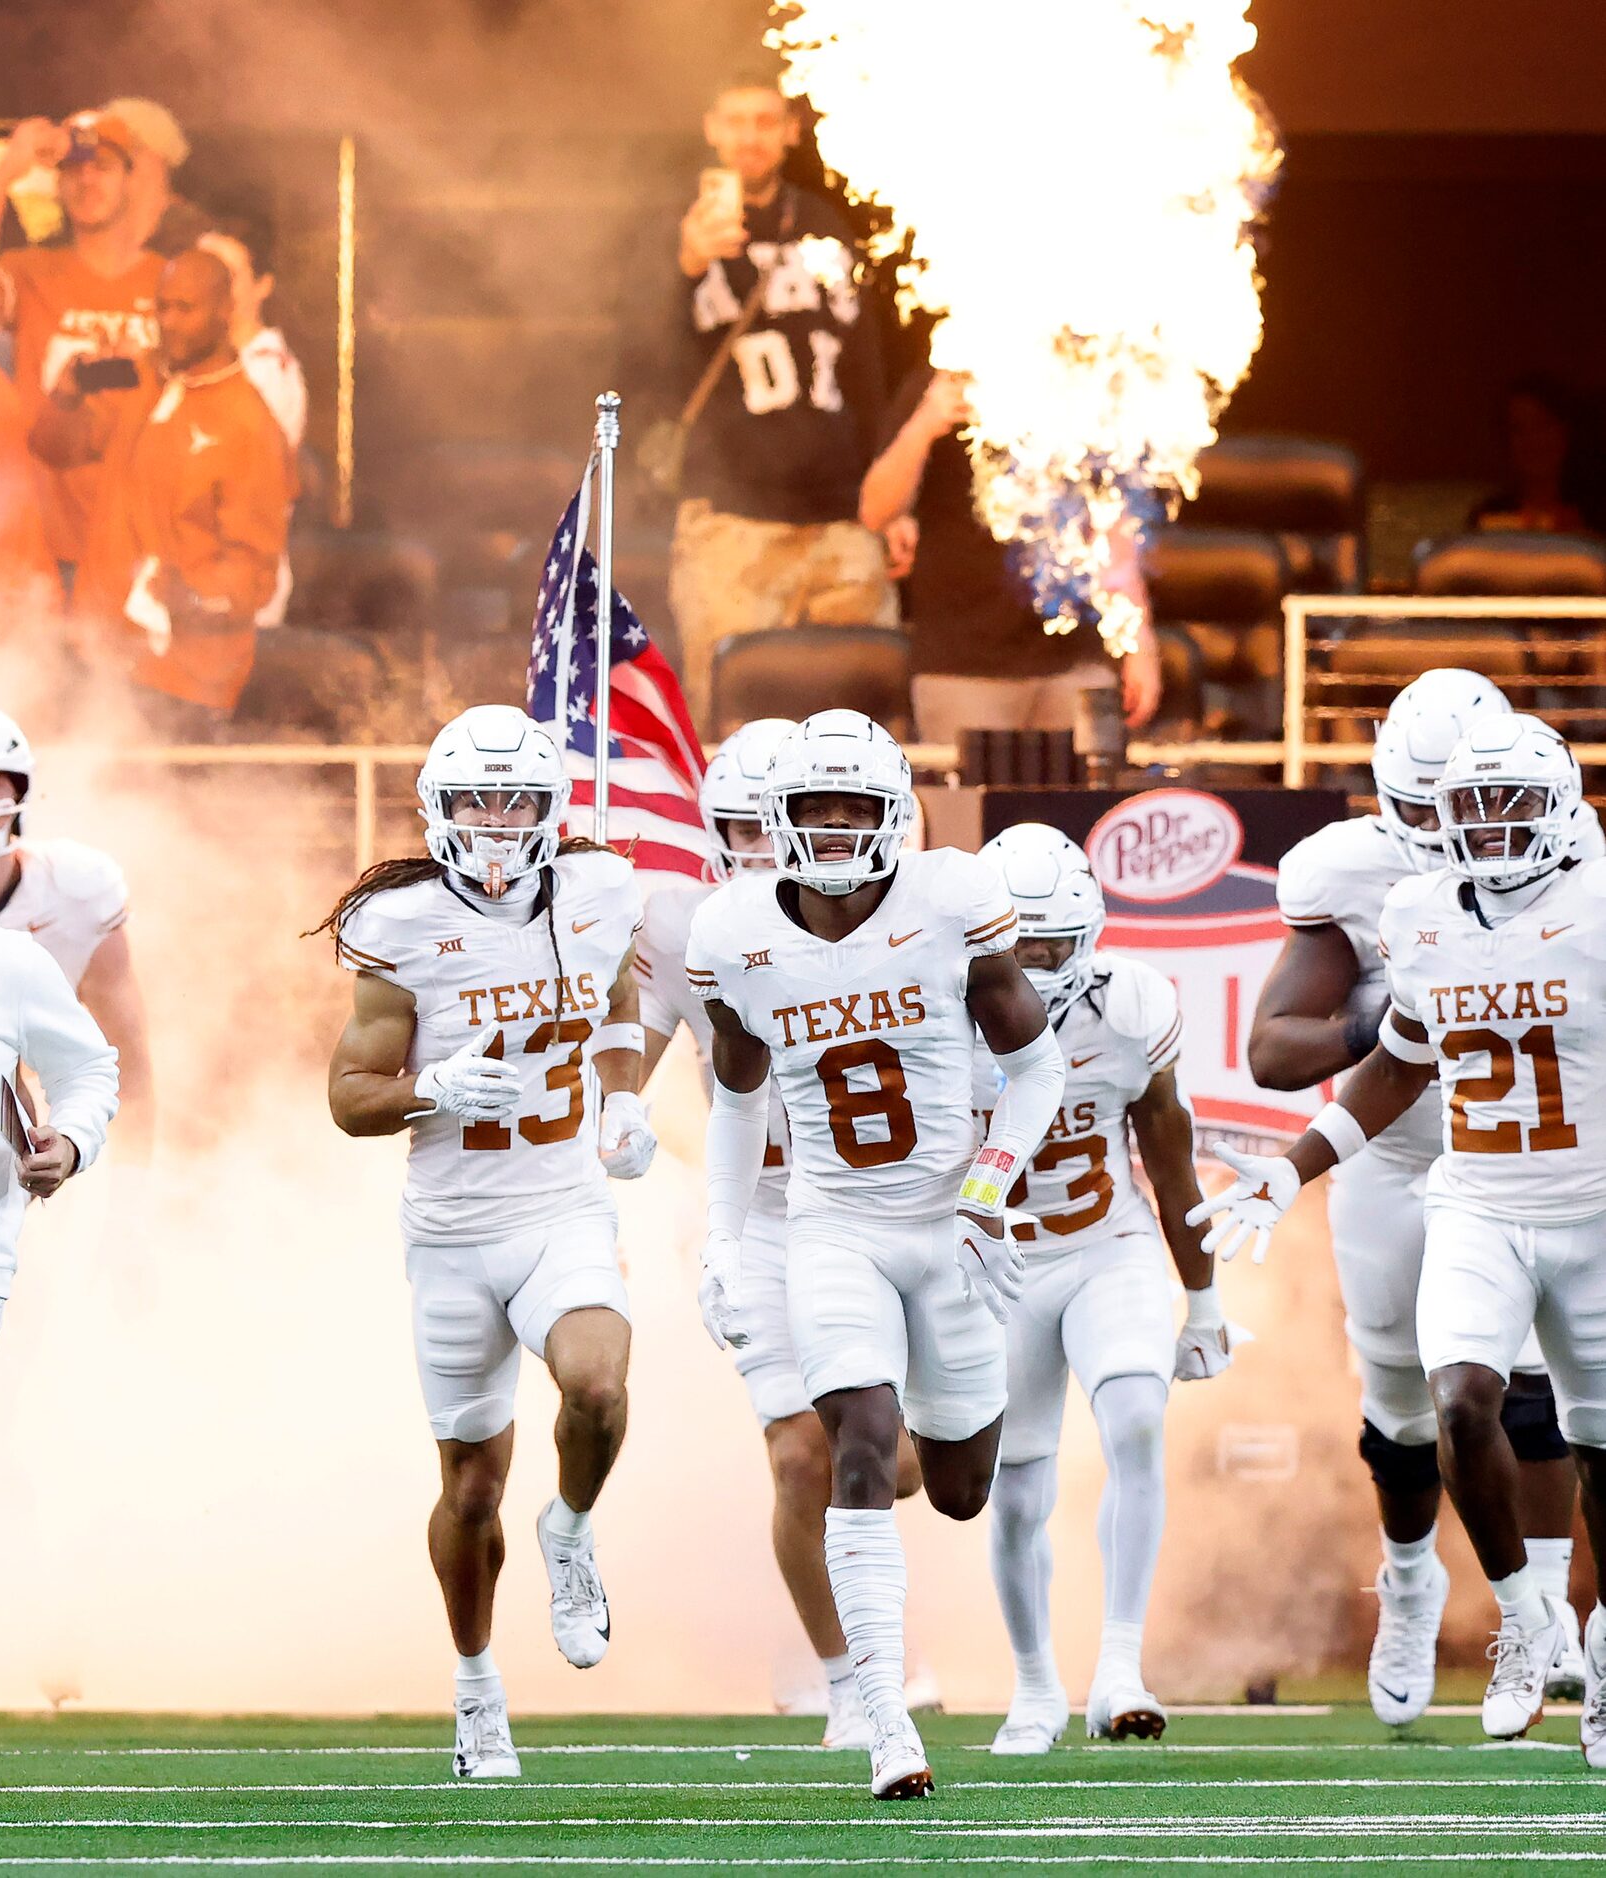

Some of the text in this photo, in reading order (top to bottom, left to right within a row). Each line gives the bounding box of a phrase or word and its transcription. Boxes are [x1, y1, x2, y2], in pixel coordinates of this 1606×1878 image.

[484, 763, 513, 773] HORNS
[1098, 820, 1219, 881] Pepper
[1147, 810, 1189, 845] Dr
[459, 972, 600, 1026] TEXAS
[772, 984, 926, 1047] TEXAS
[1430, 979, 1568, 1025] TEXAS
[815, 1038, 918, 1169] 8
[1440, 1024, 1578, 1154] 21
